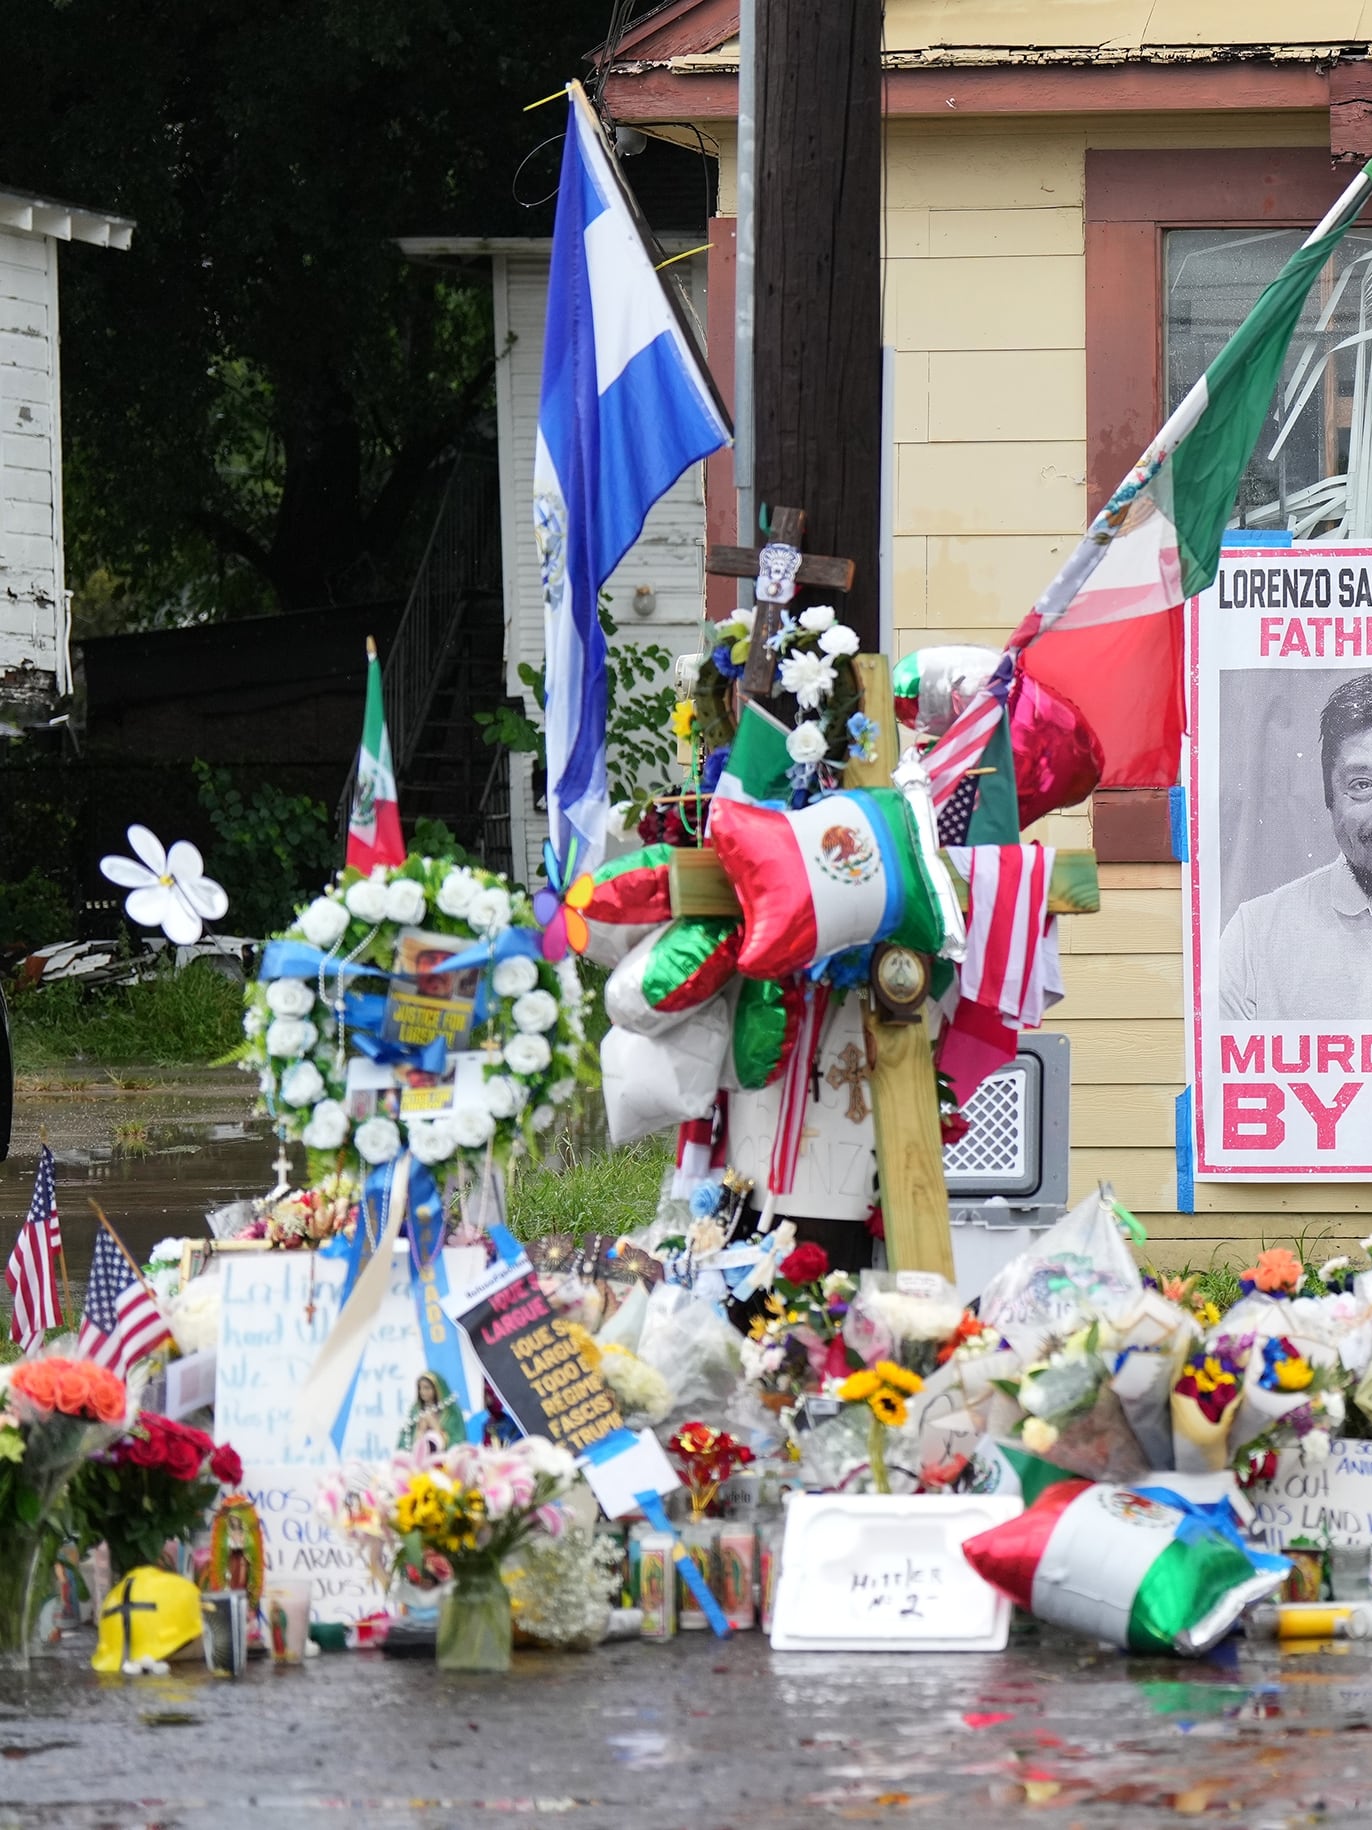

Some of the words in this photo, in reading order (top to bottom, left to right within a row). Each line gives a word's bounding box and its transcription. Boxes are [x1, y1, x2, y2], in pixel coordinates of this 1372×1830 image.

[1219, 567, 1331, 609] LORENZO
[1222, 1081, 1365, 1151] BY
[519, 1338, 582, 1380] LARGU
[548, 1396, 616, 1439] FASCIS
